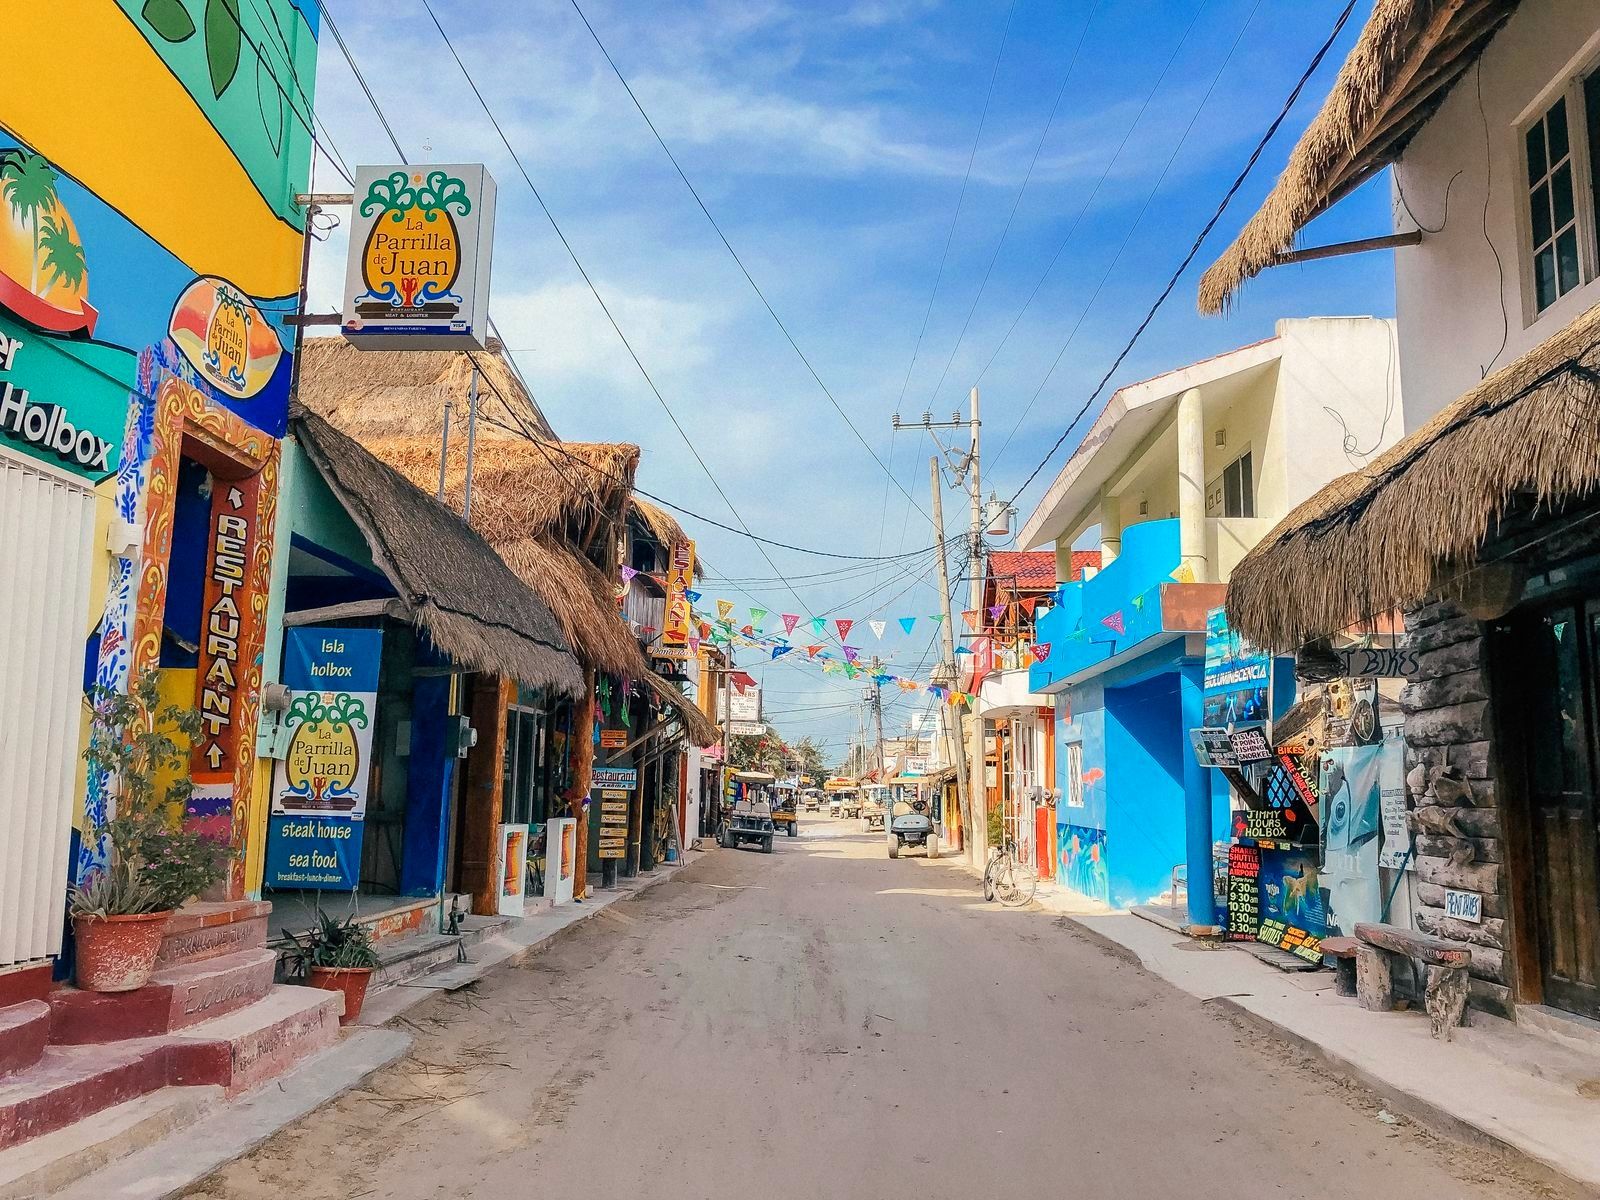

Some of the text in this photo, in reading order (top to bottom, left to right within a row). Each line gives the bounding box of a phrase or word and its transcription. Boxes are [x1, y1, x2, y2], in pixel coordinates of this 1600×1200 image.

[406, 218, 424, 231] La
[374, 233, 452, 250] Parrilla
[373, 252, 449, 276] de Juan
[226, 312, 235, 328] La
[214, 318, 243, 349] Parrilla
[215, 335, 241, 366] Juan
[0, 382, 114, 472] Holbox
[669, 541, 691, 629] RESTAURANT
[200, 512, 247, 736] RESTAURANT
[321, 639, 345, 654] Isla
[310, 662, 352, 677] holbox
[1360, 648, 1420, 677] BIKES
[318, 729, 332, 740] La
[1239, 731, 1259, 740] ISLAS
[1240, 737, 1265, 747] POINTS
[295, 741, 352, 756] Parrilla
[1239, 751, 1271, 760] SNORKEL
[1277, 747, 1305, 755] BIKES
[294, 756, 351, 776] de Juan
[592, 769, 635, 781] Restaurant
[1296, 763, 1320, 798] TOURS
[1246, 810, 1281, 819] JIMMY
[282, 820, 352, 839] steak house
[1248, 819, 1281, 828] TOURS
[1245, 827, 1287, 837] HOLBOX
[289, 849, 337, 868] sea food
[1230, 854, 1258, 862] SHUTTLE
[1231, 847, 1258, 855] SHARED
[1229, 869, 1258, 877] AIRPORT
[1230, 882, 1250, 893] 7:30
